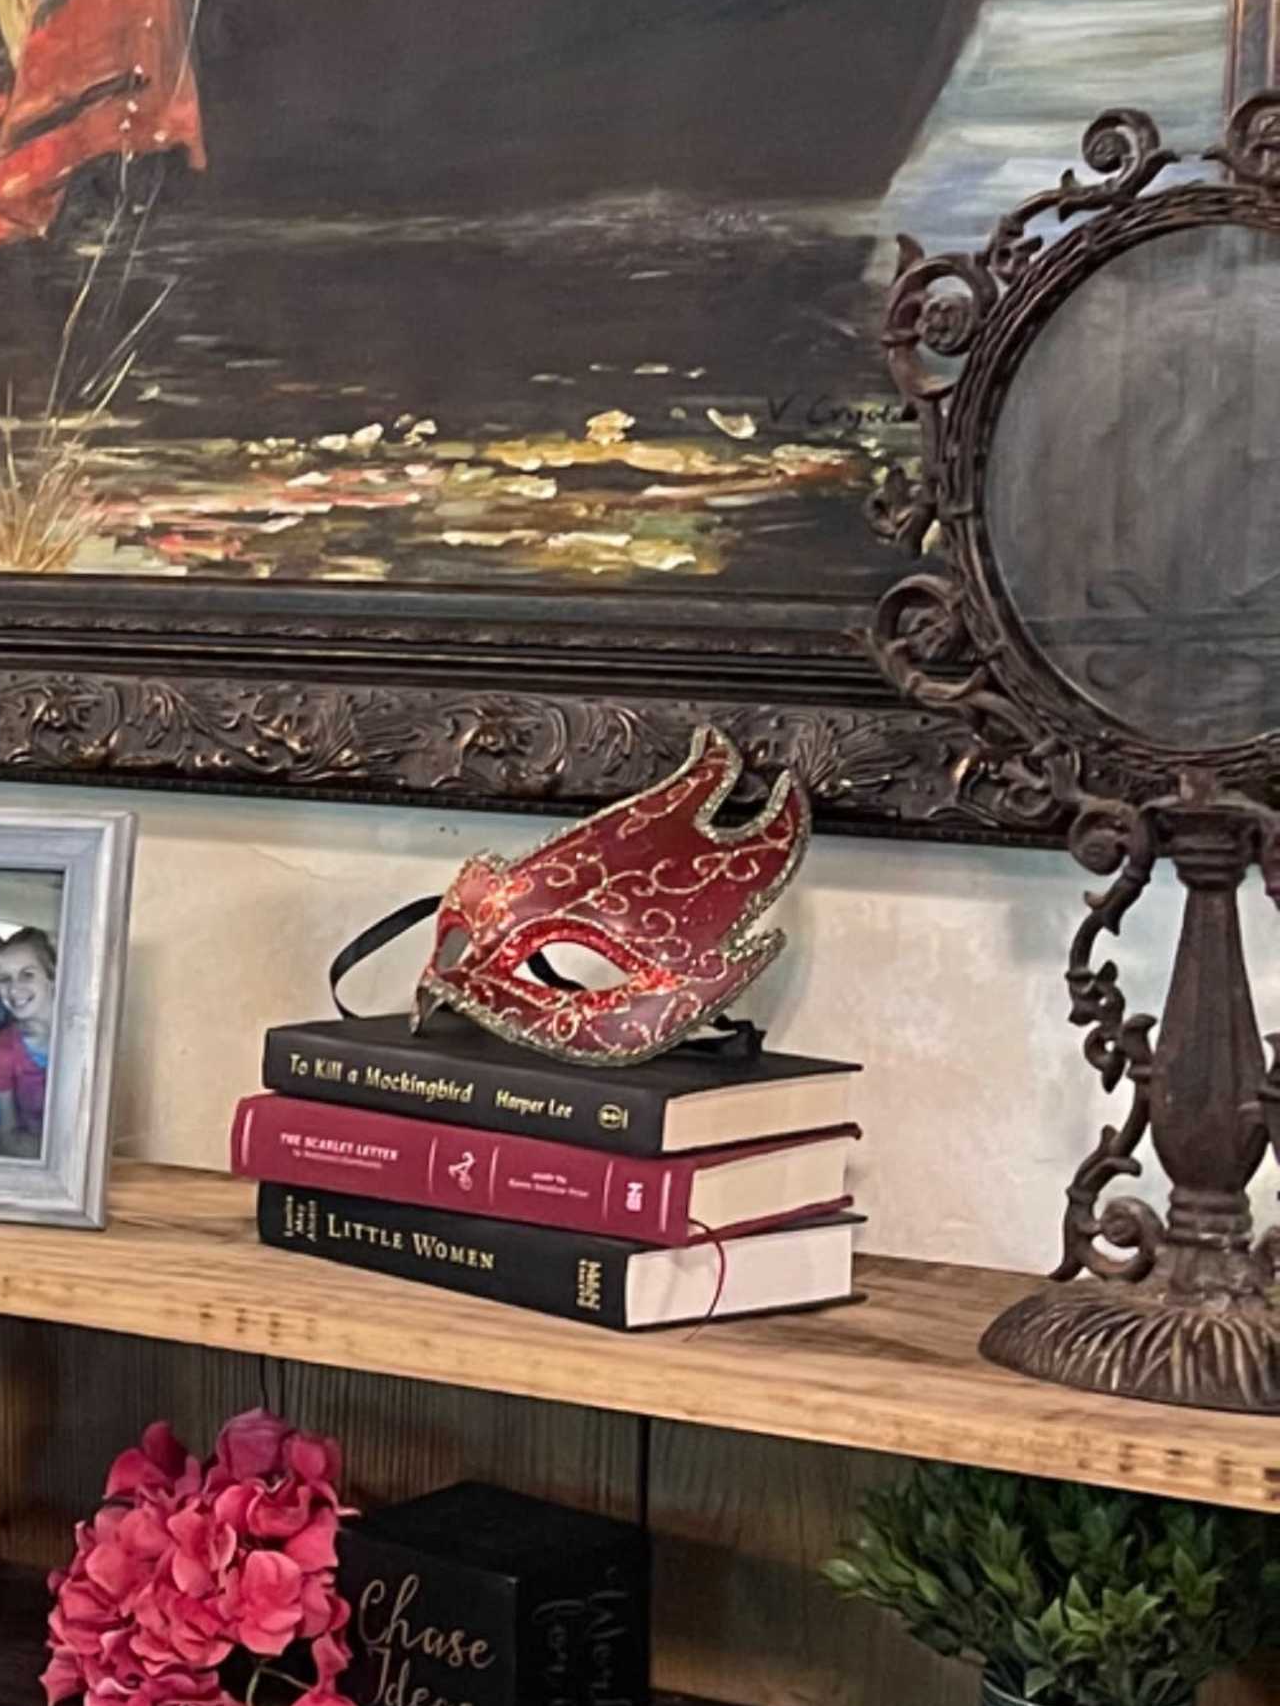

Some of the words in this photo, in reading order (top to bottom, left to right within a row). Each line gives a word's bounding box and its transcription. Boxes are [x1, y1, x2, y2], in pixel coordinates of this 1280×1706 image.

[290, 1053, 308, 1076] To
[314, 1058, 344, 1083] Kill
[347, 1068, 358, 1084] a
[365, 1065, 475, 1104] Mockingbird
[495, 1089, 545, 1116] Harper
[548, 1098, 574, 1120] Lee
[280, 1132, 301, 1146] THE
[304, 1135, 355, 1155] SCARLET
[356, 1143, 399, 1162] LETTER
[327, 1213, 404, 1250] LITTLE
[412, 1232, 496, 1271] WOMEN
[358, 1573, 496, 1669] Chase
